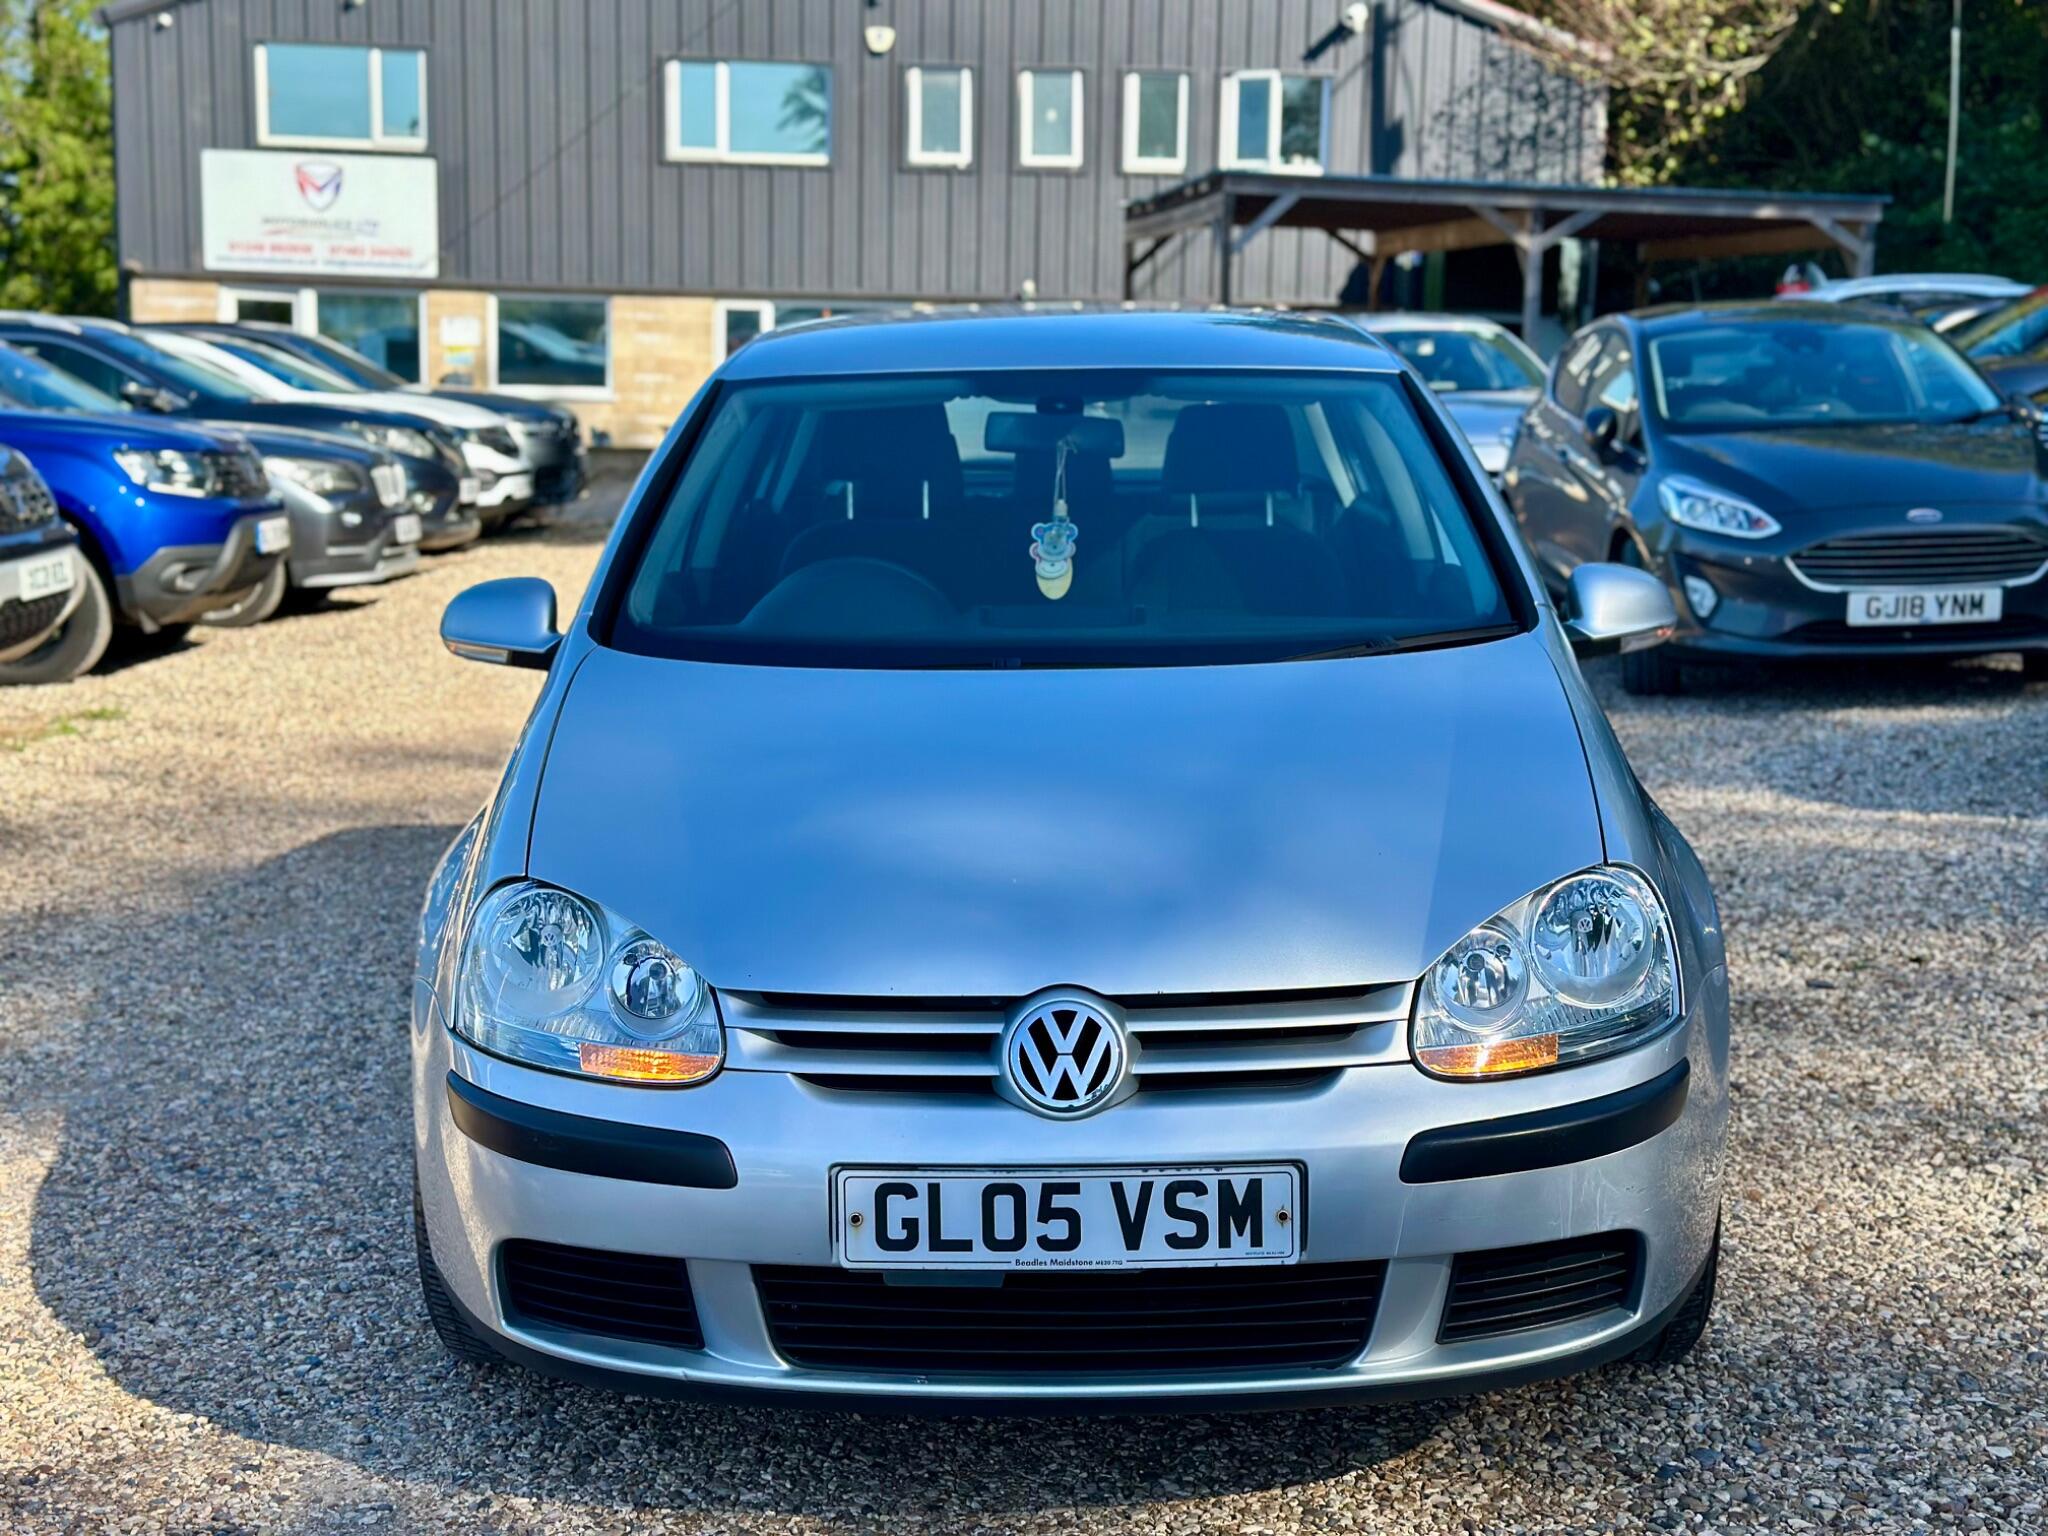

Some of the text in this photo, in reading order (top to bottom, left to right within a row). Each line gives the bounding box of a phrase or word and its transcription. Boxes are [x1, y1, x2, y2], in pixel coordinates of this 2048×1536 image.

[1865, 593, 1984, 619] GJ18 YNM
[1010, 1000, 1119, 1108] VW
[874, 1178, 1263, 1253] GL05 VSM
[1015, 1259, 1047, 1267] Beadles
[1049, 1258, 1093, 1266] Maidstone
